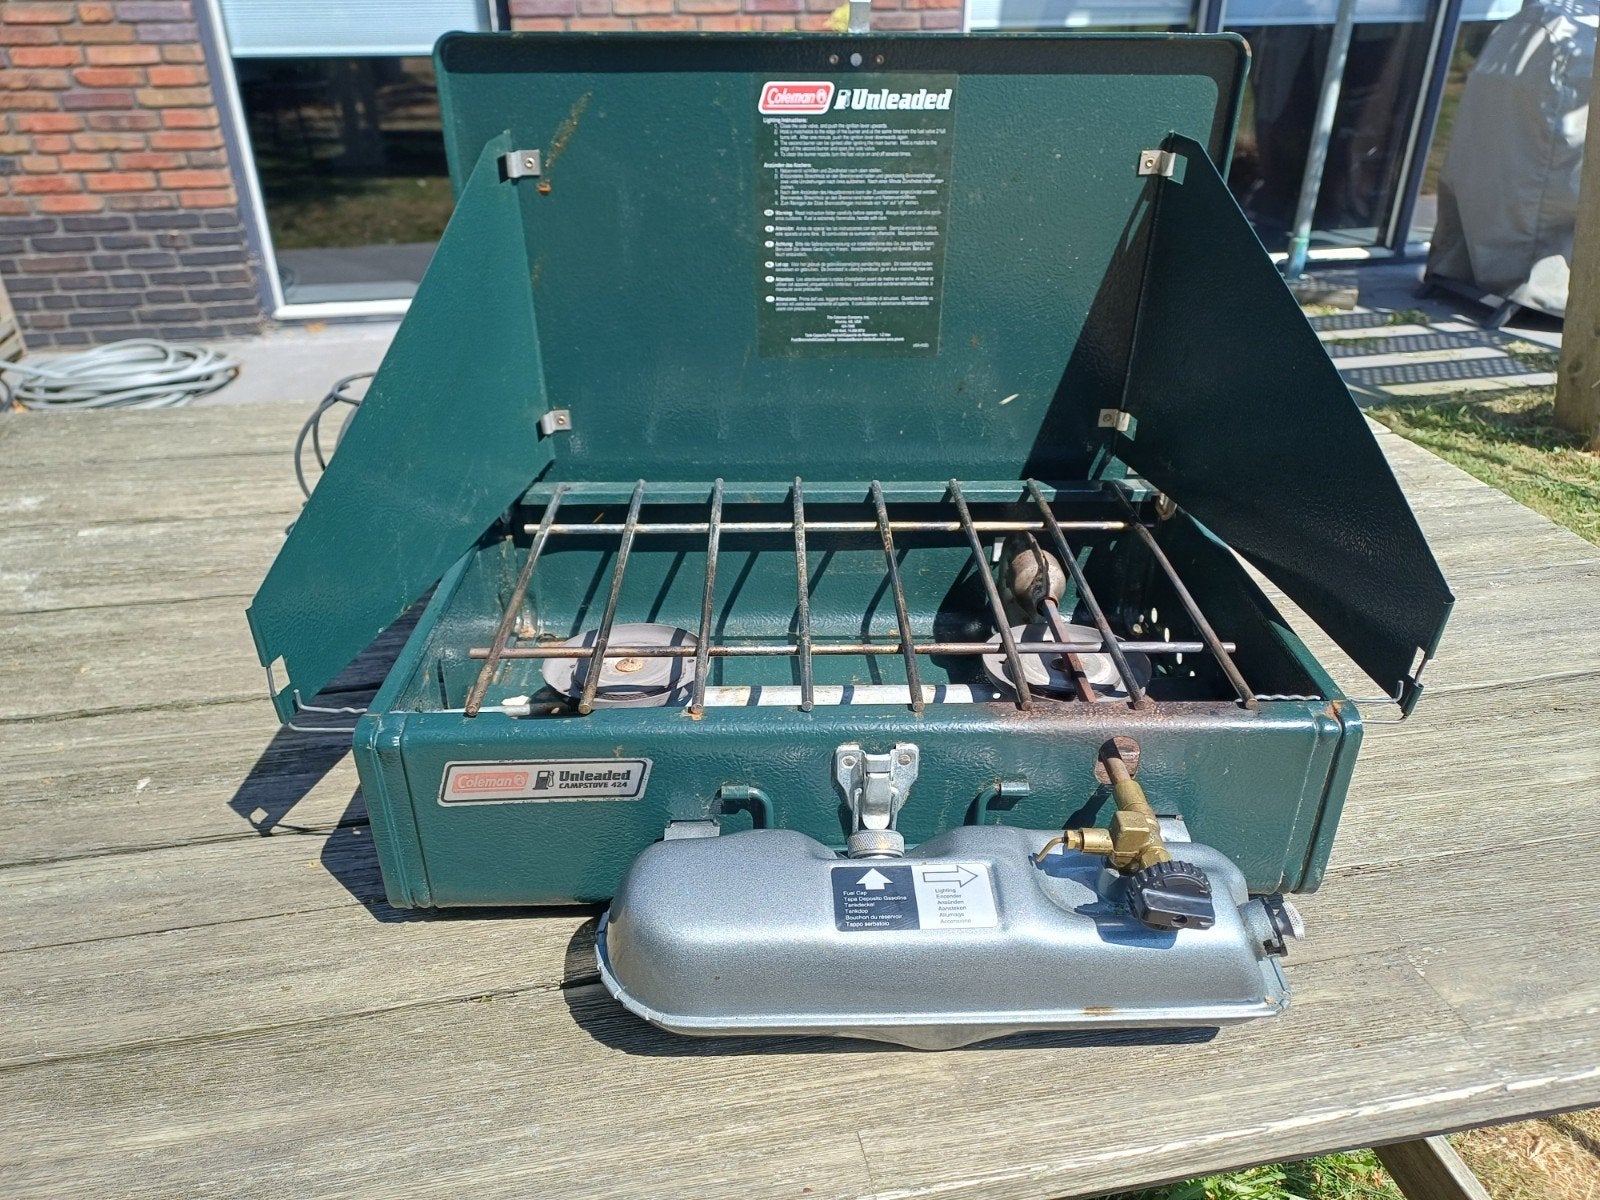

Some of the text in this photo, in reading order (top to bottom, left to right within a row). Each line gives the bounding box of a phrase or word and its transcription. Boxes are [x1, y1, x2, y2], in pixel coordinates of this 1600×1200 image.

[767, 87, 953, 110] Coleman Unleaded
[457, 774, 512, 789] Coleman
[559, 770, 631, 781] Unleaded
